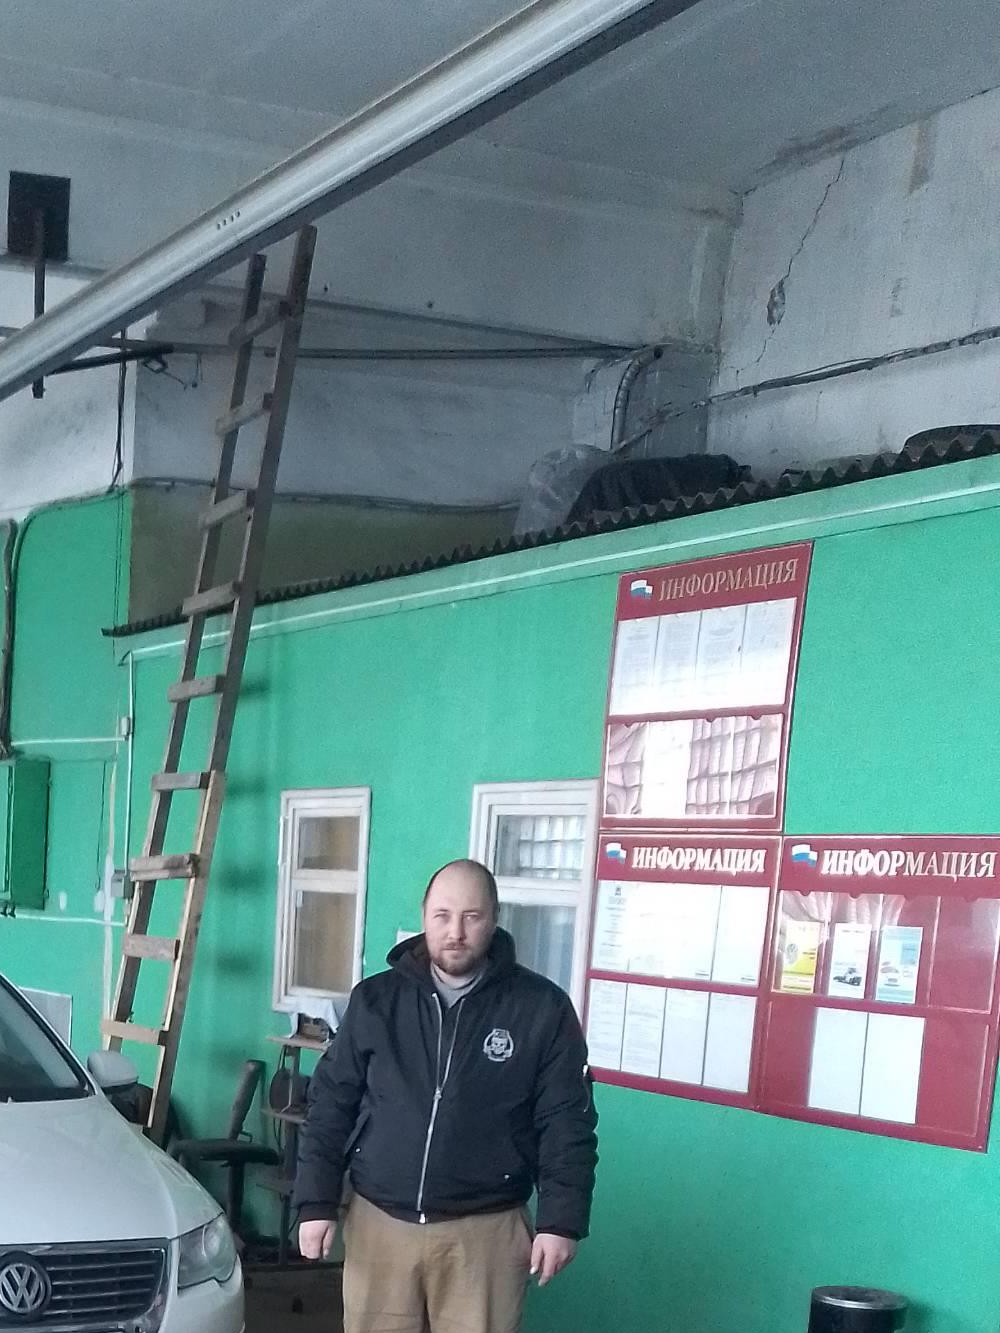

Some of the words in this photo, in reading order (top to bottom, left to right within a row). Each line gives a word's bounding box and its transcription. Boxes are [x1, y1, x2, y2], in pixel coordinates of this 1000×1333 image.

[658, 558, 799, 602] ИНФОРМАЦИЯ
[632, 846, 768, 875] ИНФОРМАЦИЯ
[821, 849, 998, 882] ИНФОРМАЦИЯ
